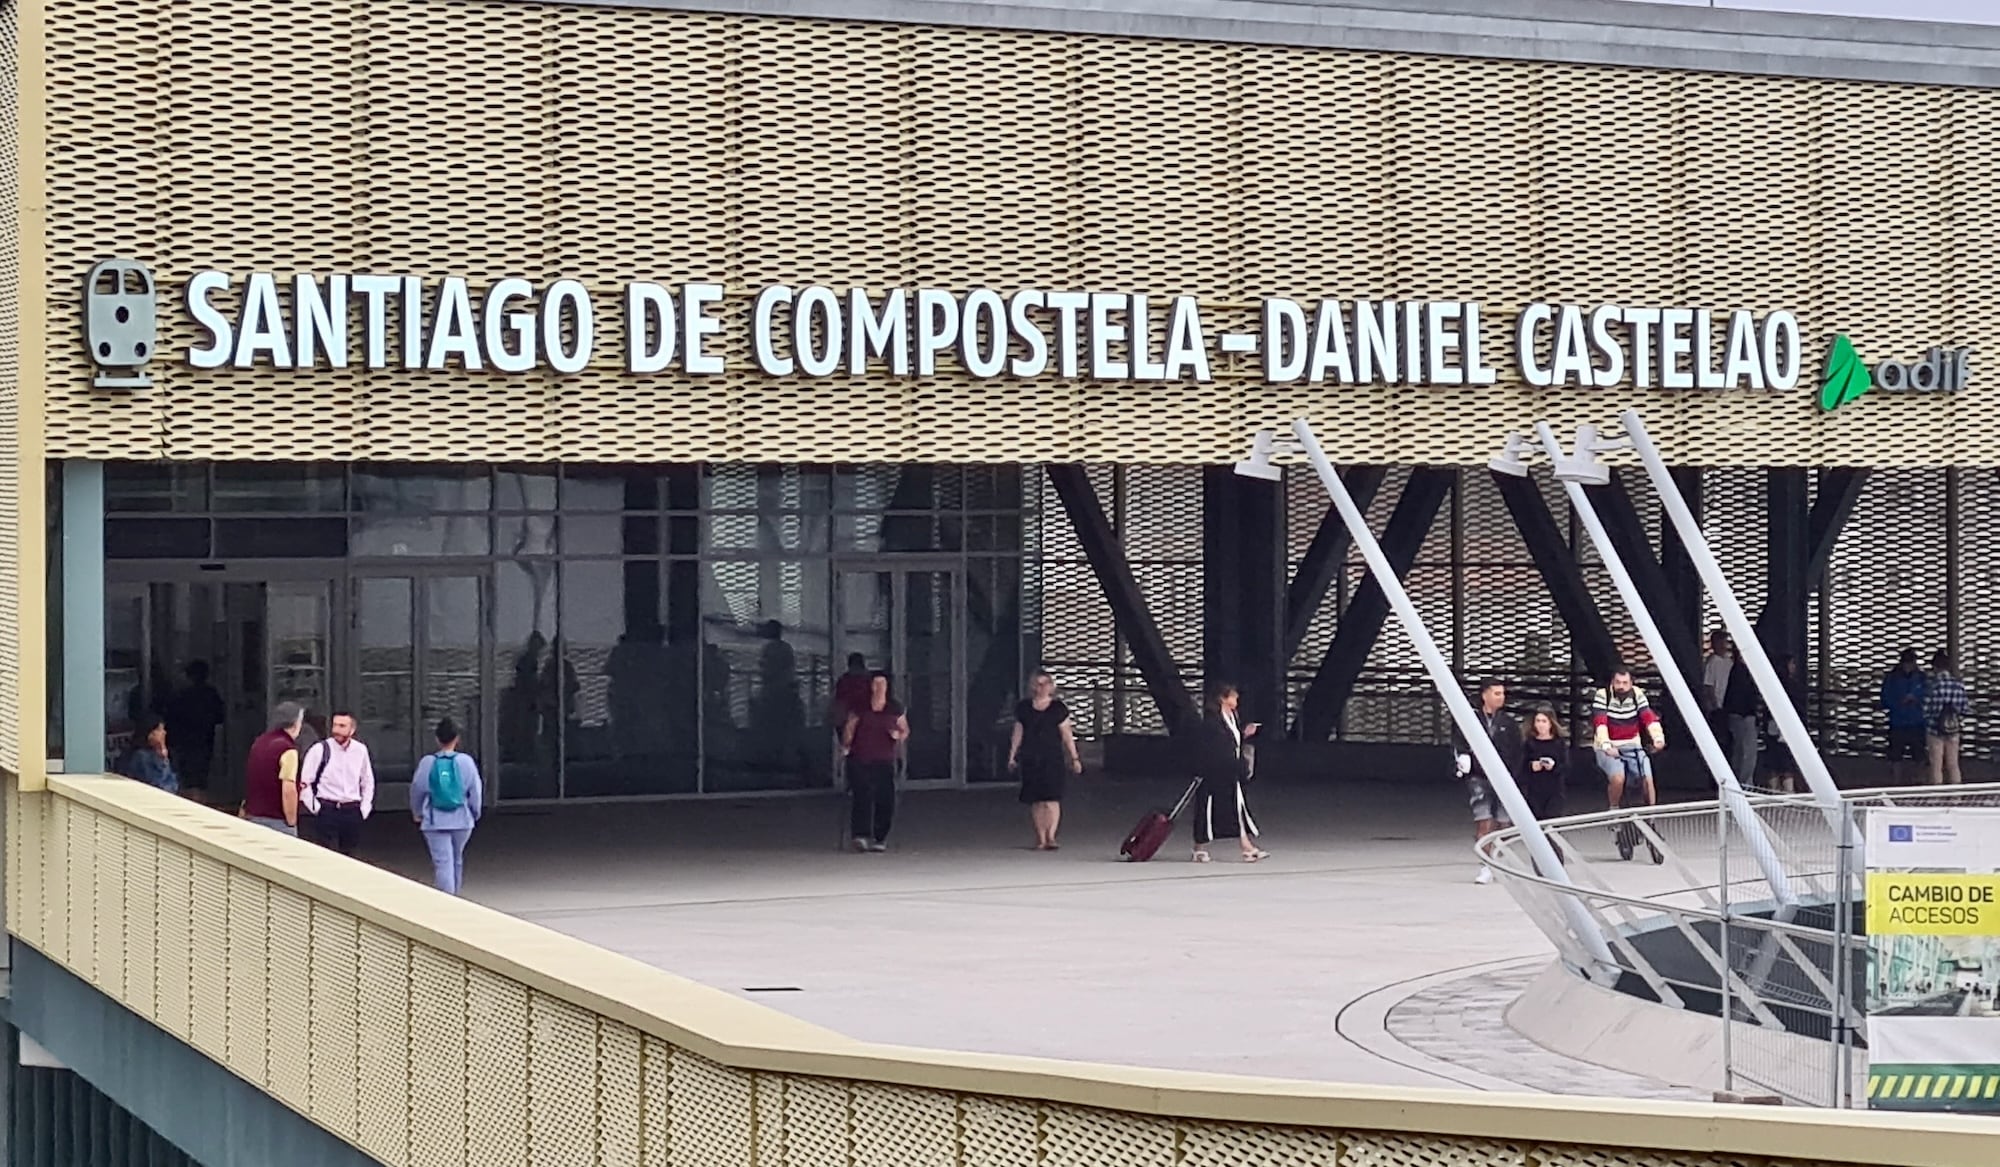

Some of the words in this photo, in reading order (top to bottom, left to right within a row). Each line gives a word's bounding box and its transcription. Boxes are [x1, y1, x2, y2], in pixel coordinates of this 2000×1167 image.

[186, 271, 594, 374] SANTIAGO
[626, 281, 725, 374] DE
[1518, 302, 1801, 391] CASTELAO
[1875, 345, 1974, 392] adif
[1888, 885, 1963, 903] CAMBIO
[1968, 886, 1994, 903] DE
[1889, 906, 1979, 924] ACCESOS
